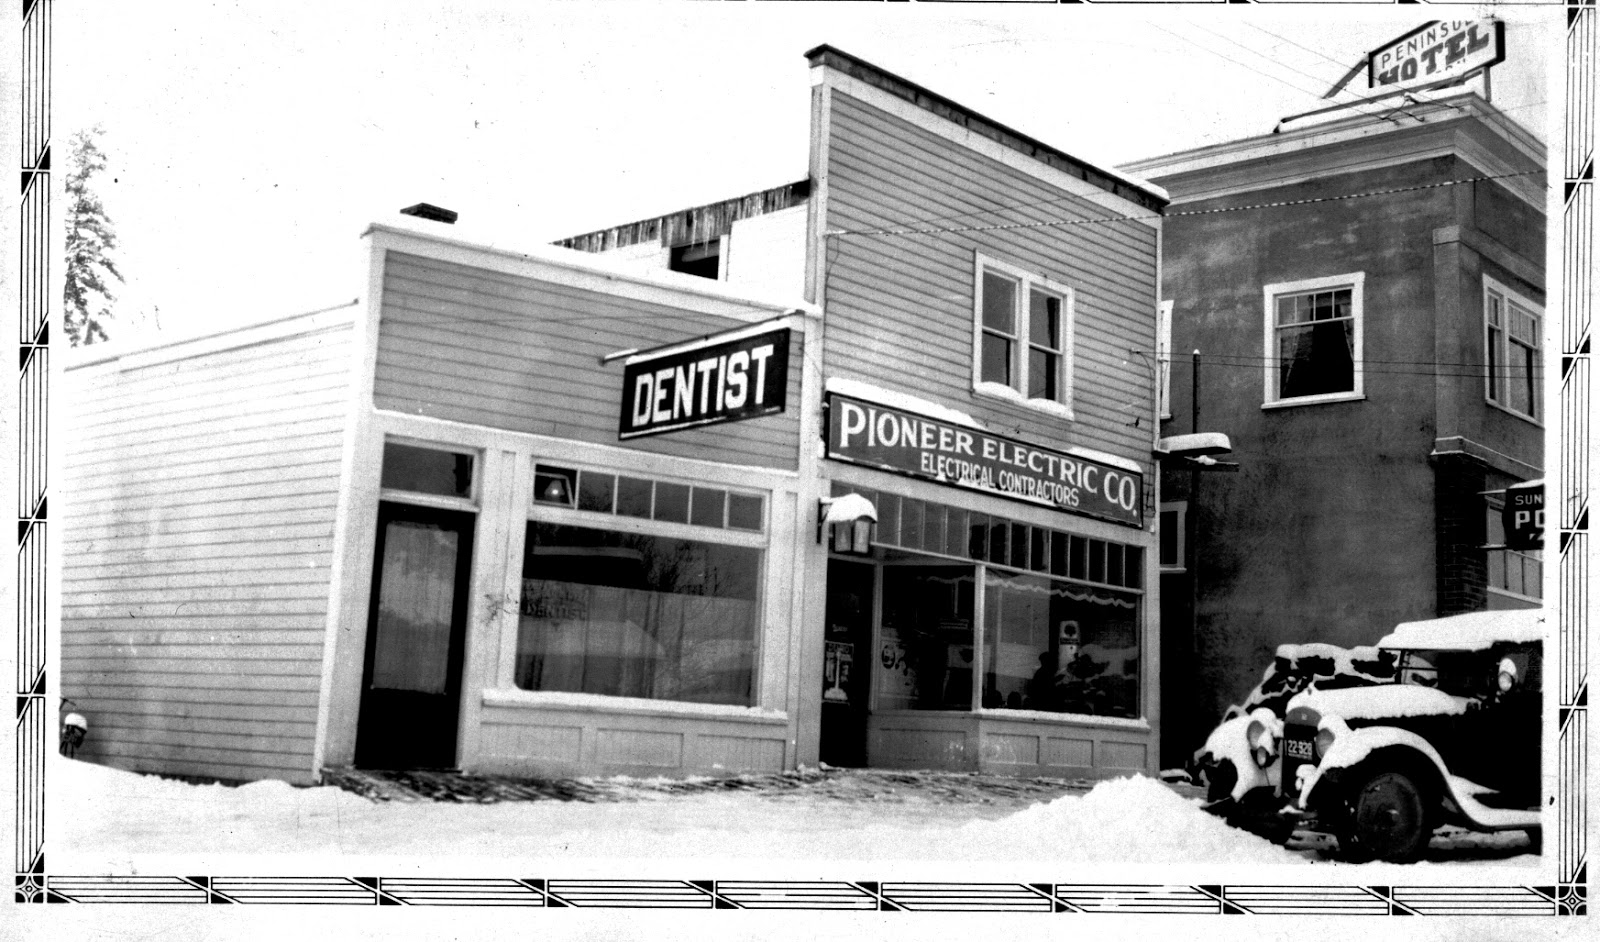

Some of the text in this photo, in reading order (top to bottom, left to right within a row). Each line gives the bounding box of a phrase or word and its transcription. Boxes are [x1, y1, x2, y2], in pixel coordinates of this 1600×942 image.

[1378, 24, 1490, 85] HOTEL
[632, 344, 775, 427] DENTIST
[839, 402, 1138, 517] PIONEER ELECTRIC CO.
[921, 452, 1080, 507] ELECTRICAL CONTRACTORS
